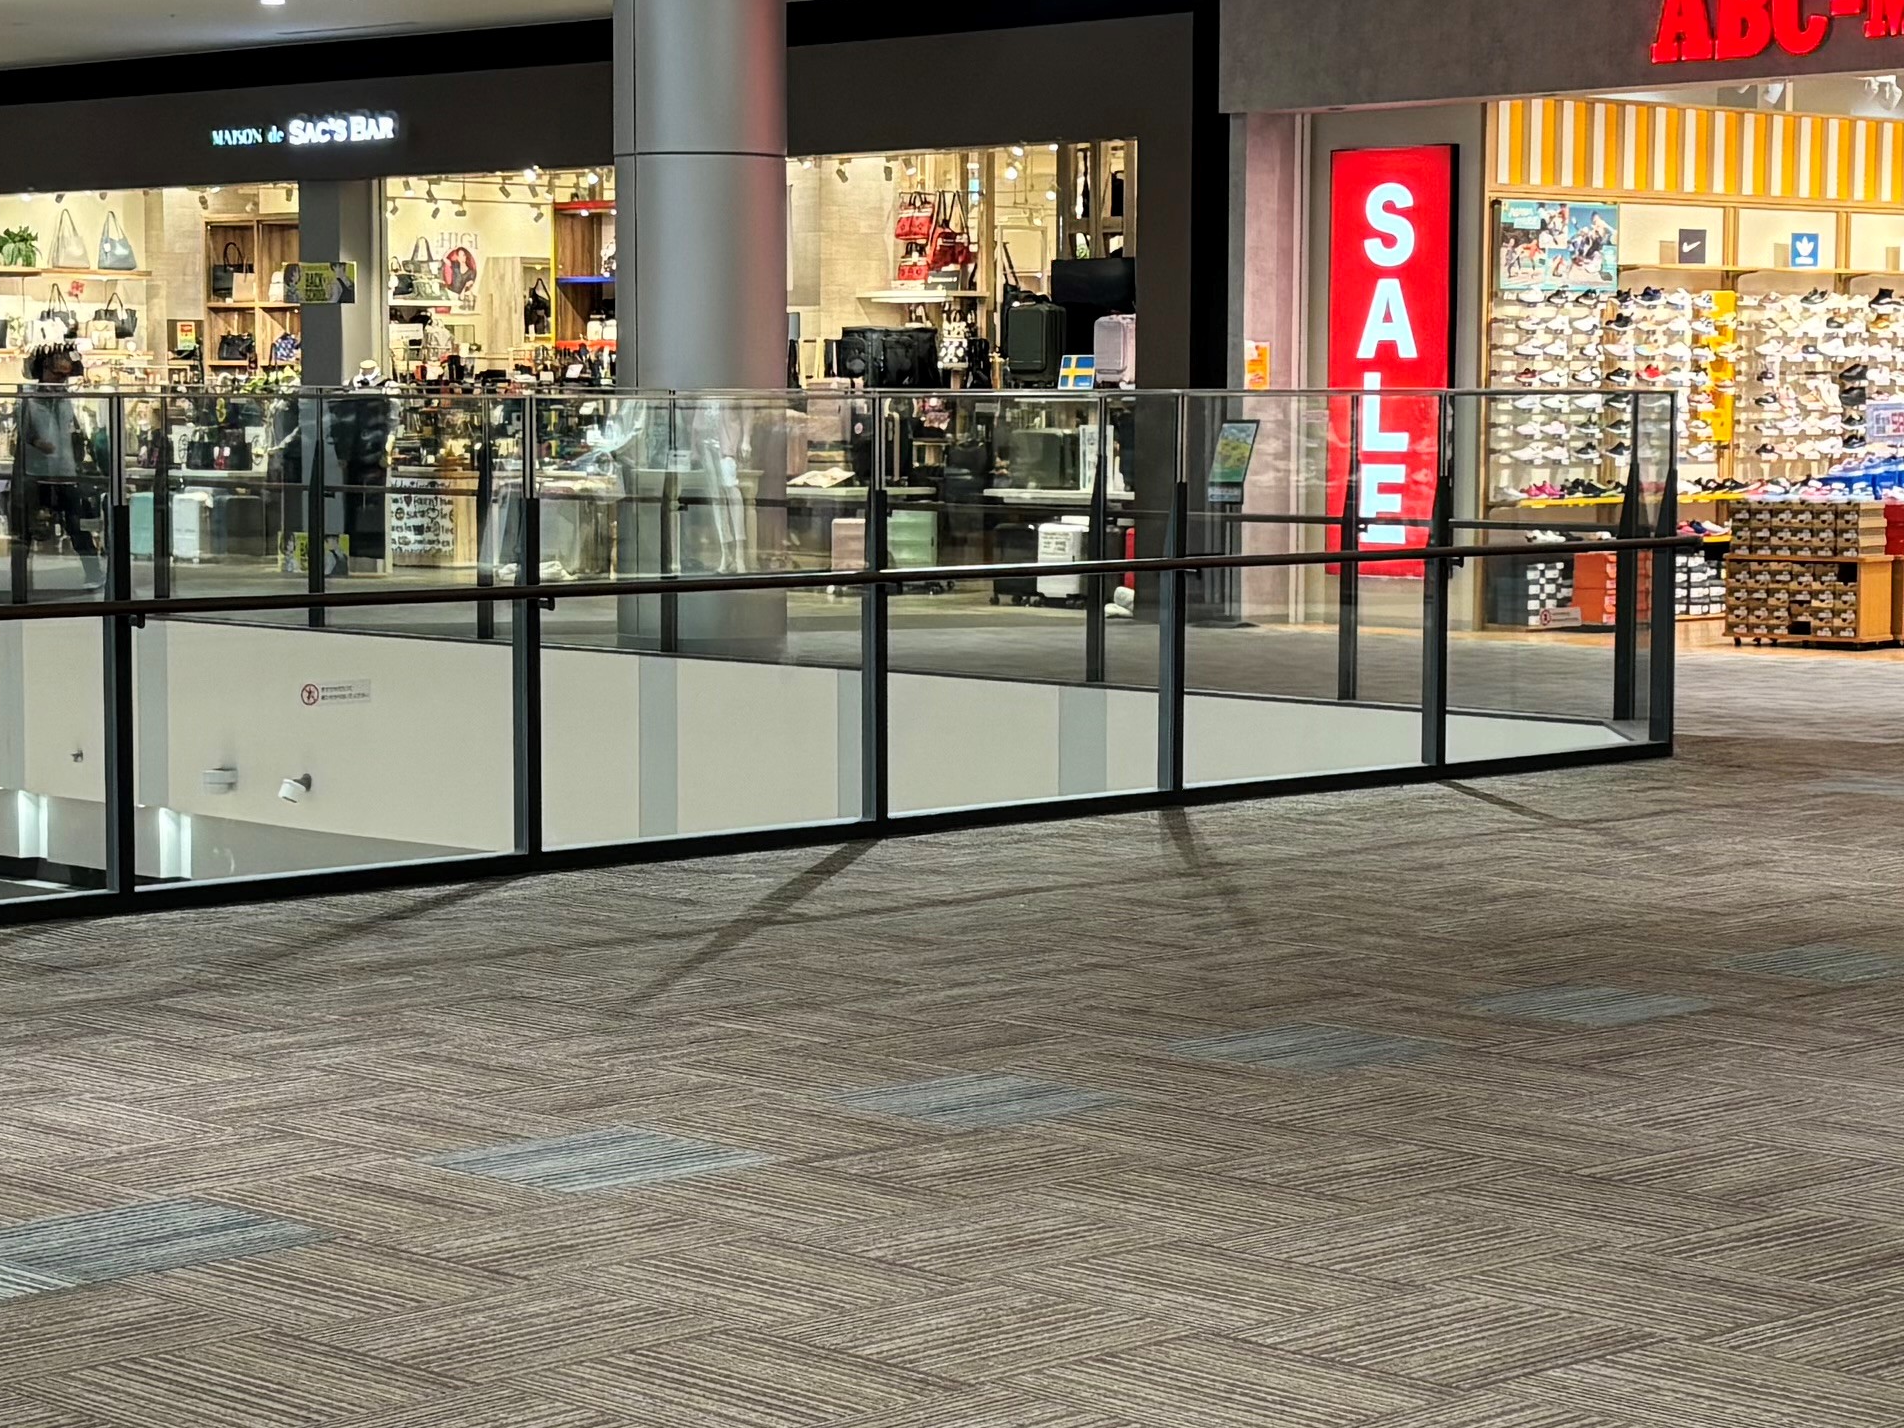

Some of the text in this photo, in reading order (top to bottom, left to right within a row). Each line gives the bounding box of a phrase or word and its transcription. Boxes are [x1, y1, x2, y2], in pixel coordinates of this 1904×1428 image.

[211, 116, 395, 146] MAISON de SAC'S BAR
[1355, 181, 1418, 545] SALE
